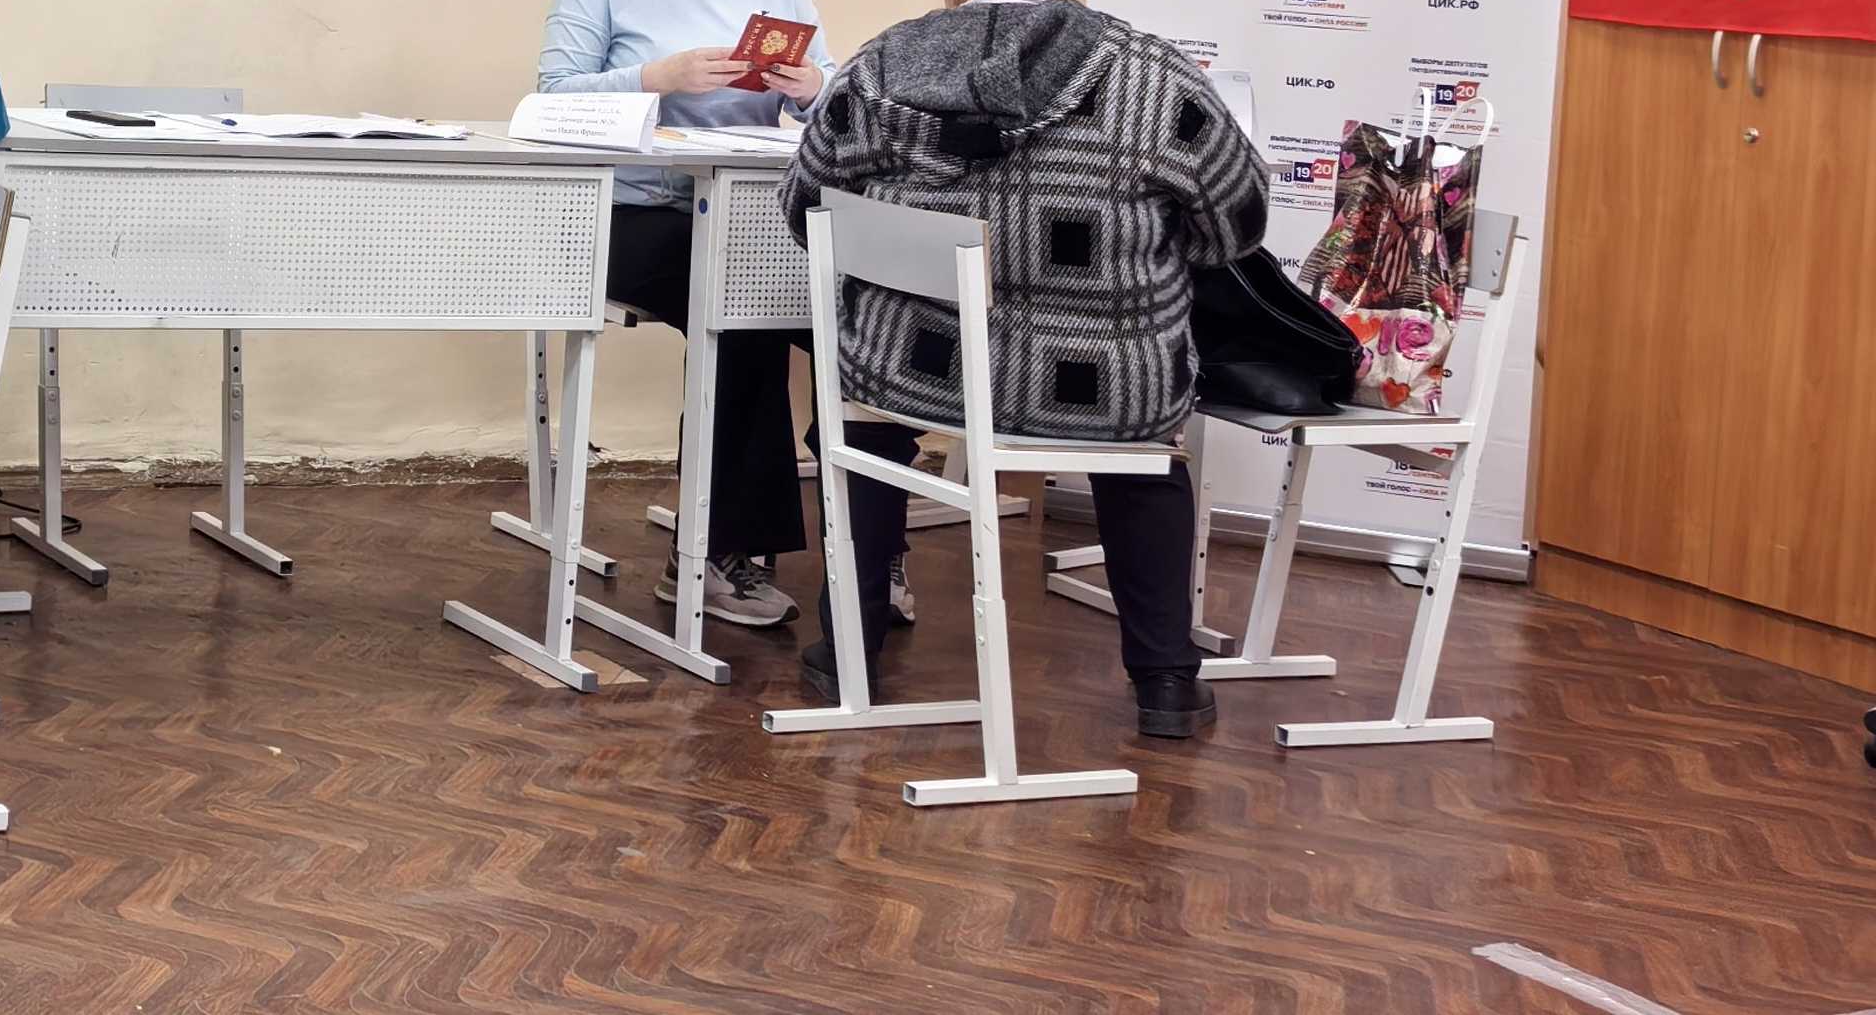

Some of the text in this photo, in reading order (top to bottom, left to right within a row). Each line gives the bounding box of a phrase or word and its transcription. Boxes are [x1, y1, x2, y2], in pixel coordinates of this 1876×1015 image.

[744, 23, 763, 55] РОССИЯ
[1286, 76, 1335, 90] ЦИК.РФ
[1438, 85, 1475, 100] 19 20
[1279, 163, 1331, 182] 18 19 20
